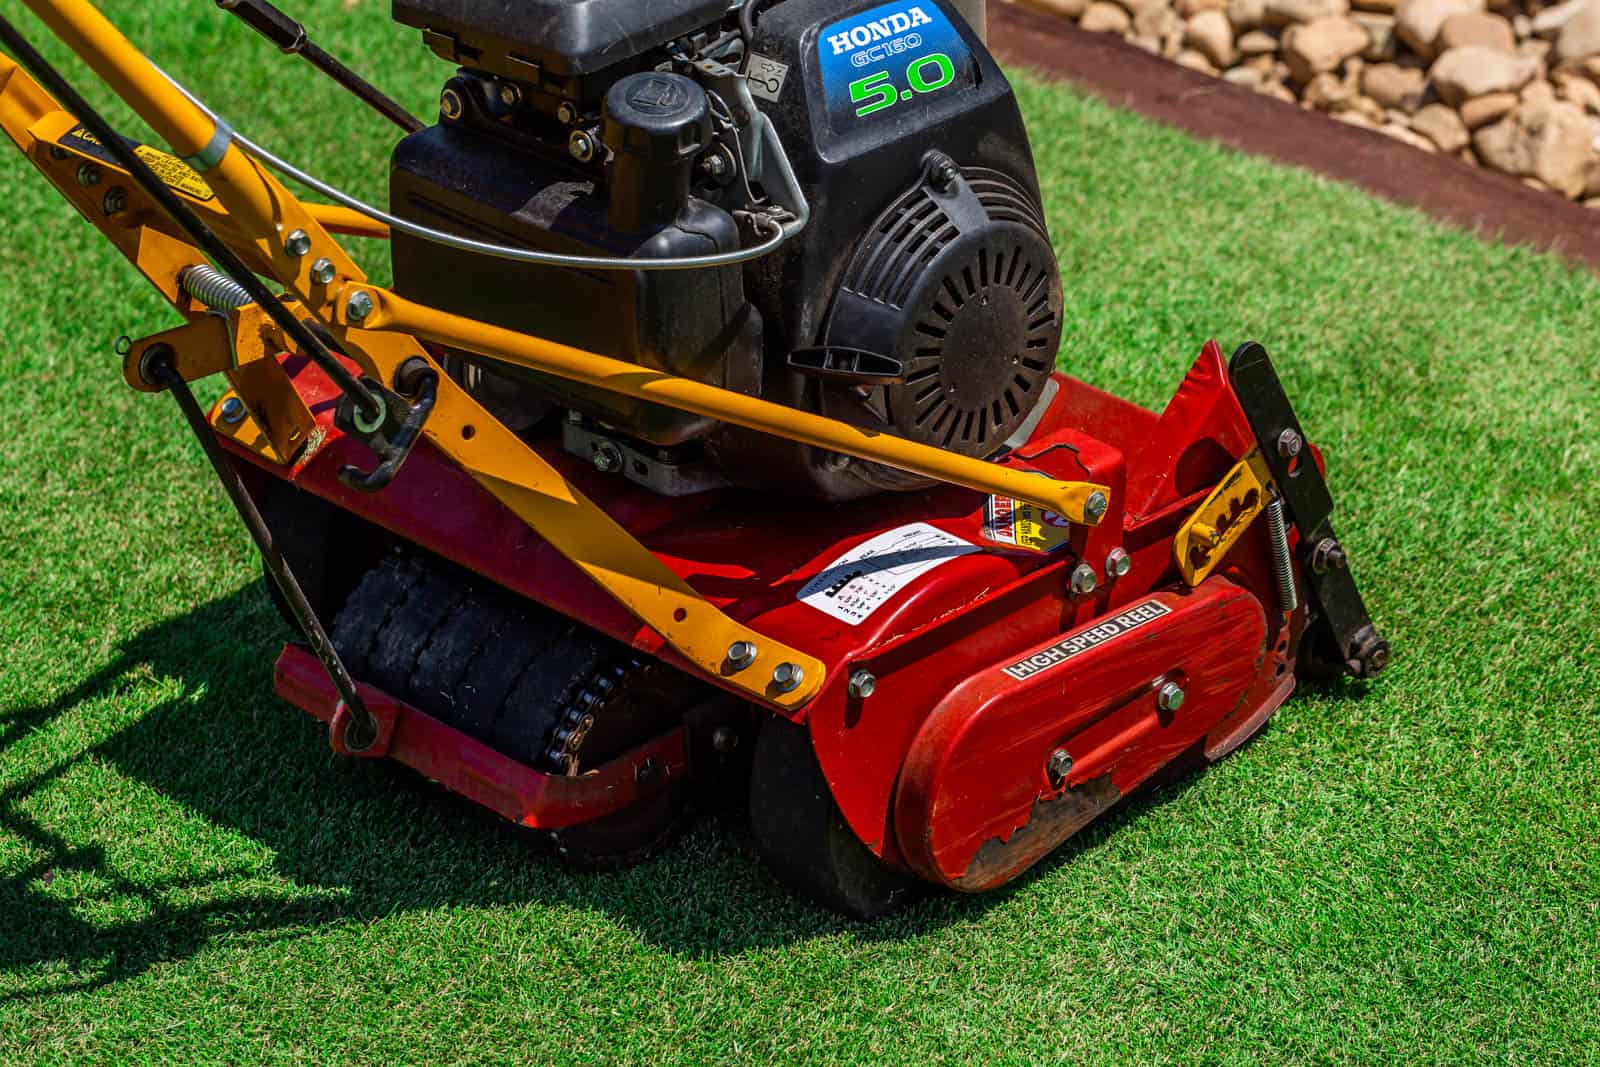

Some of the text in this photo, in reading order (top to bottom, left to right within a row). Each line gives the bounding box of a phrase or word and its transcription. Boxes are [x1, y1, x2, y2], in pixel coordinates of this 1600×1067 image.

[827, 6, 932, 55] HONDA
[850, 32, 922, 68] GC160
[848, 52, 955, 117] 5.0
[1009, 602, 1163, 677] HIGH SPEED REEL
